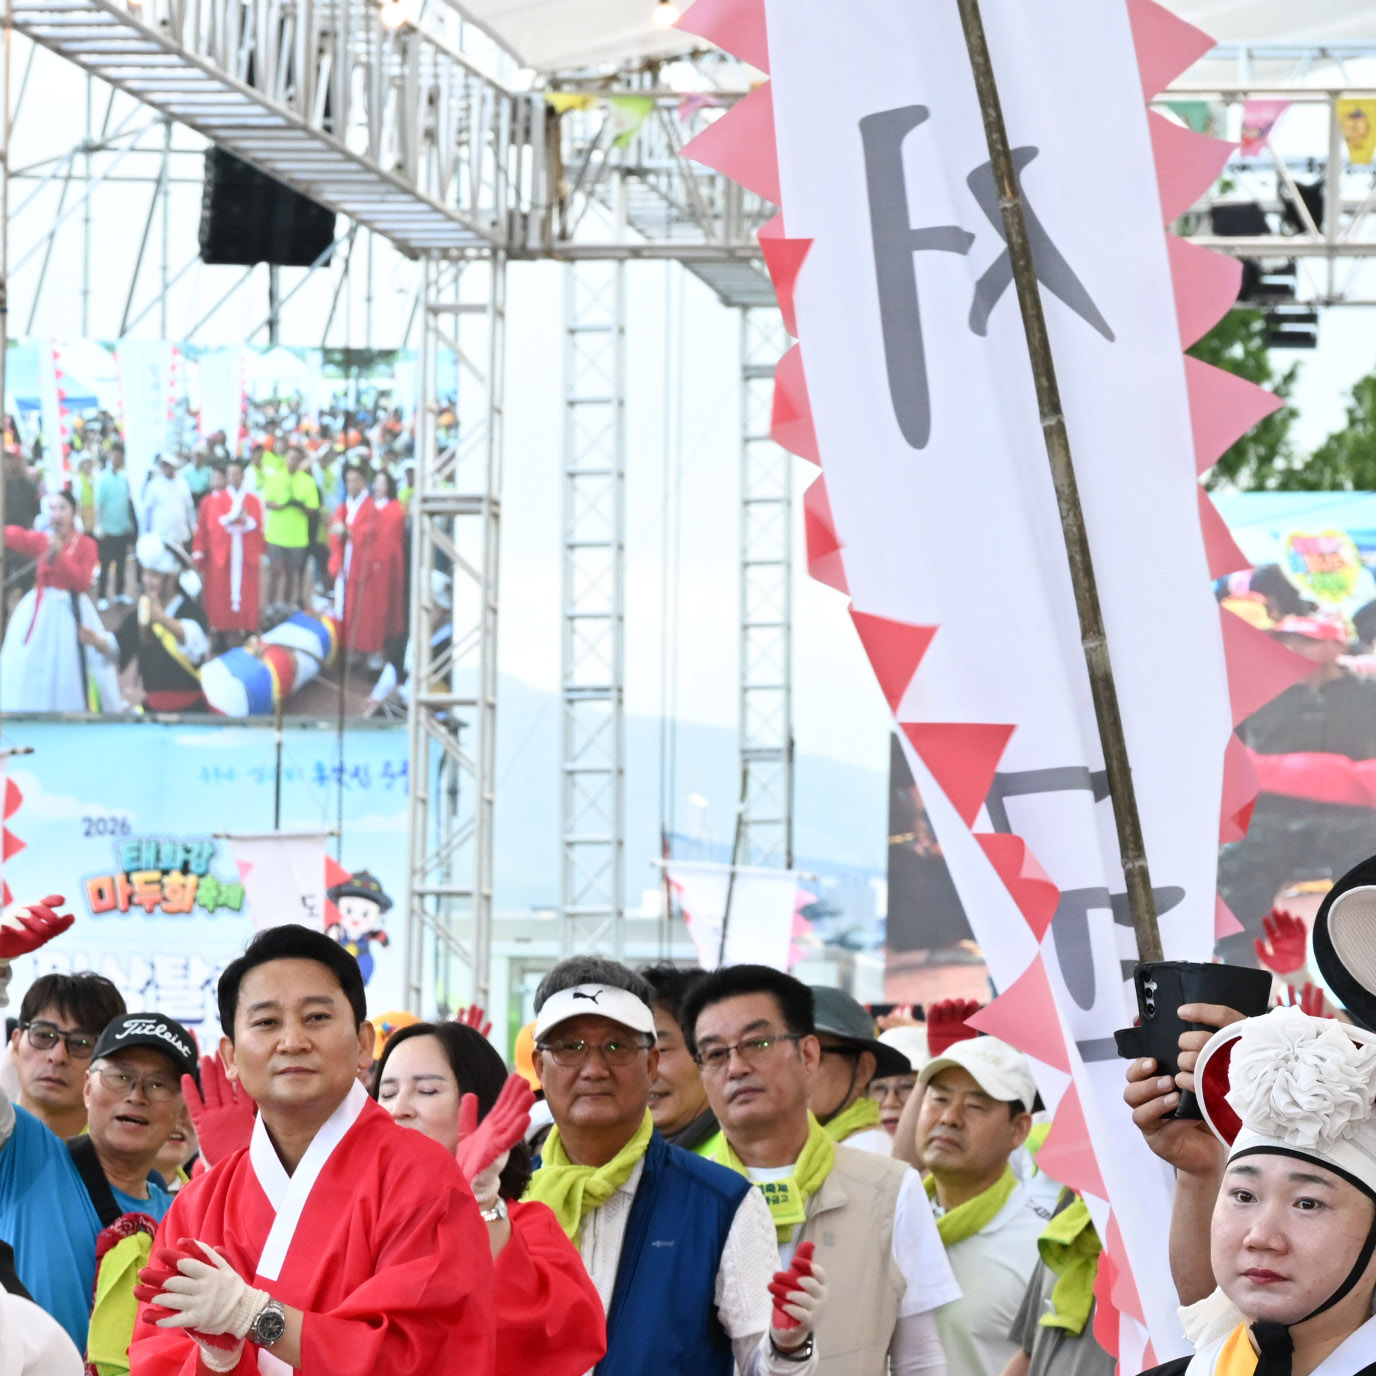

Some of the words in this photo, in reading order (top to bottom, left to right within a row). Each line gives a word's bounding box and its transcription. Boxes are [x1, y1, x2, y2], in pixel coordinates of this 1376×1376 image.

[82, 816, 132, 838] 2026
[119, 839, 217, 877] 태화강
[115, 1018, 193, 1058] Titleist
